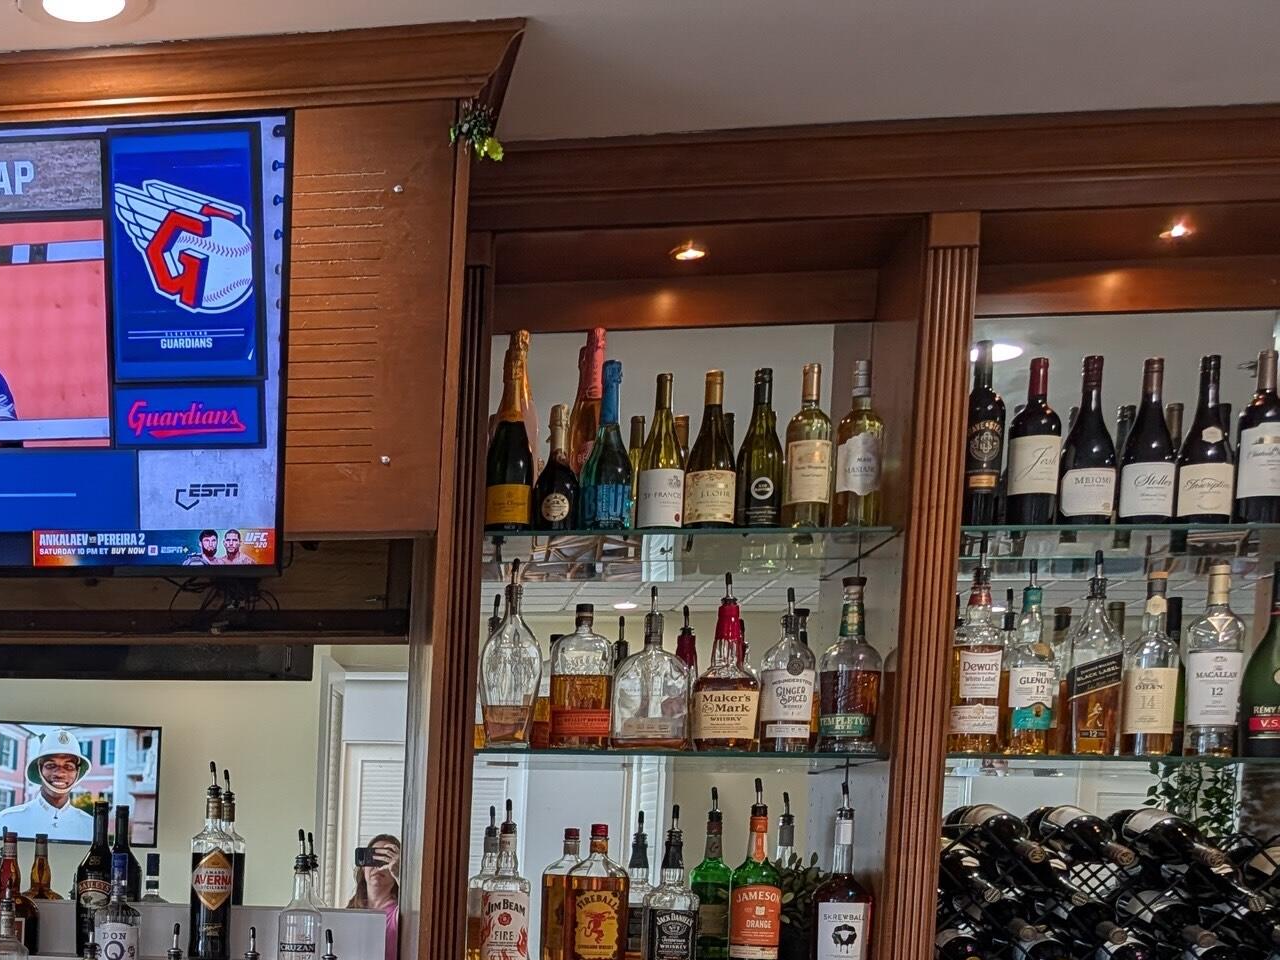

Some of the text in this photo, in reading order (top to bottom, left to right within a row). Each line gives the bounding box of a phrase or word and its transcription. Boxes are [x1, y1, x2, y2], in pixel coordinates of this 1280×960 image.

[160, 337, 213, 349] GUARDIANS
[127, 399, 247, 438] Guardians
[1074, 476, 1111, 484] MEIOMI
[189, 484, 238, 497] ESPN
[39, 533, 89, 546] ANKALAEV
[97, 532, 136, 545] PEREIRA
[138, 532, 145, 545] 2
[245, 532, 269, 542] UFC
[39, 546, 145, 555] SATURDAY 10 PM ET BUY NOW
[1195, 671, 1238, 679] MACALLAN
[776, 686, 806, 697] GINGER
[1211, 687, 1223, 696] 12
[702, 694, 751, 702] Maker's
[779, 694, 808, 705] SPICED
[1141, 695, 1155, 709] 14
[715, 703, 751, 712] Mark
[194, 874, 231, 885] AVERNA
[79, 880, 111, 893] BAILEYS
[736, 890, 781, 903] JAMESON
[485, 898, 526, 917] JIM BEAM
[746, 919, 772, 929] ORANGE
[102, 932, 127, 940] DON
[494, 930, 514, 941] FIRE
[280, 943, 315, 952] CRUZAN
